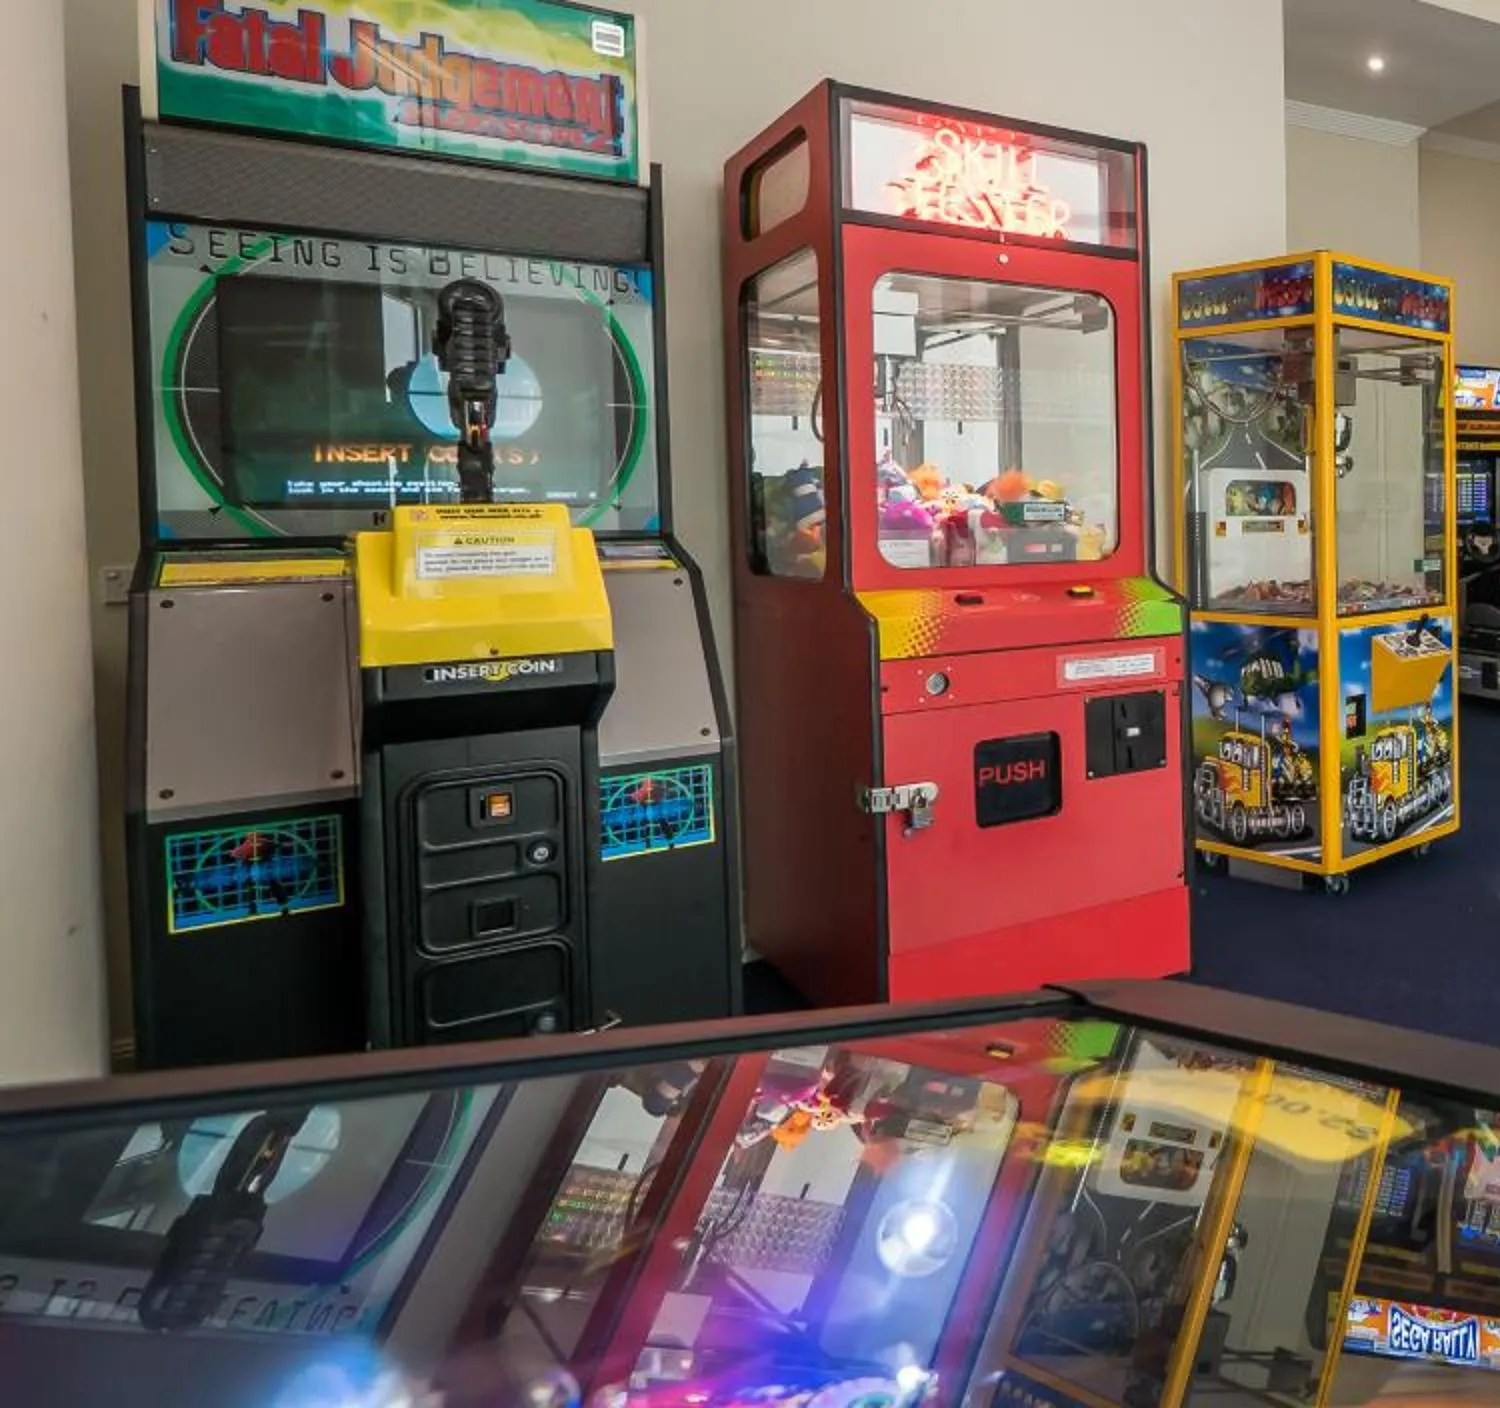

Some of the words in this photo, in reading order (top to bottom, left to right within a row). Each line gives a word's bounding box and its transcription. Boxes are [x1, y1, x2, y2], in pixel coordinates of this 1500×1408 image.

[171, 0, 327, 85] Fatal
[330, 18, 624, 152] Judgement
[167, 223, 341, 269] SEEING
[367, 245, 409, 275] IS
[428, 250, 643, 297] BELIEVING!
[313, 444, 412, 465] INSERT
[433, 665, 498, 682] INSERT
[507, 658, 555, 675] COIN
[978, 759, 1046, 787] PUSH
